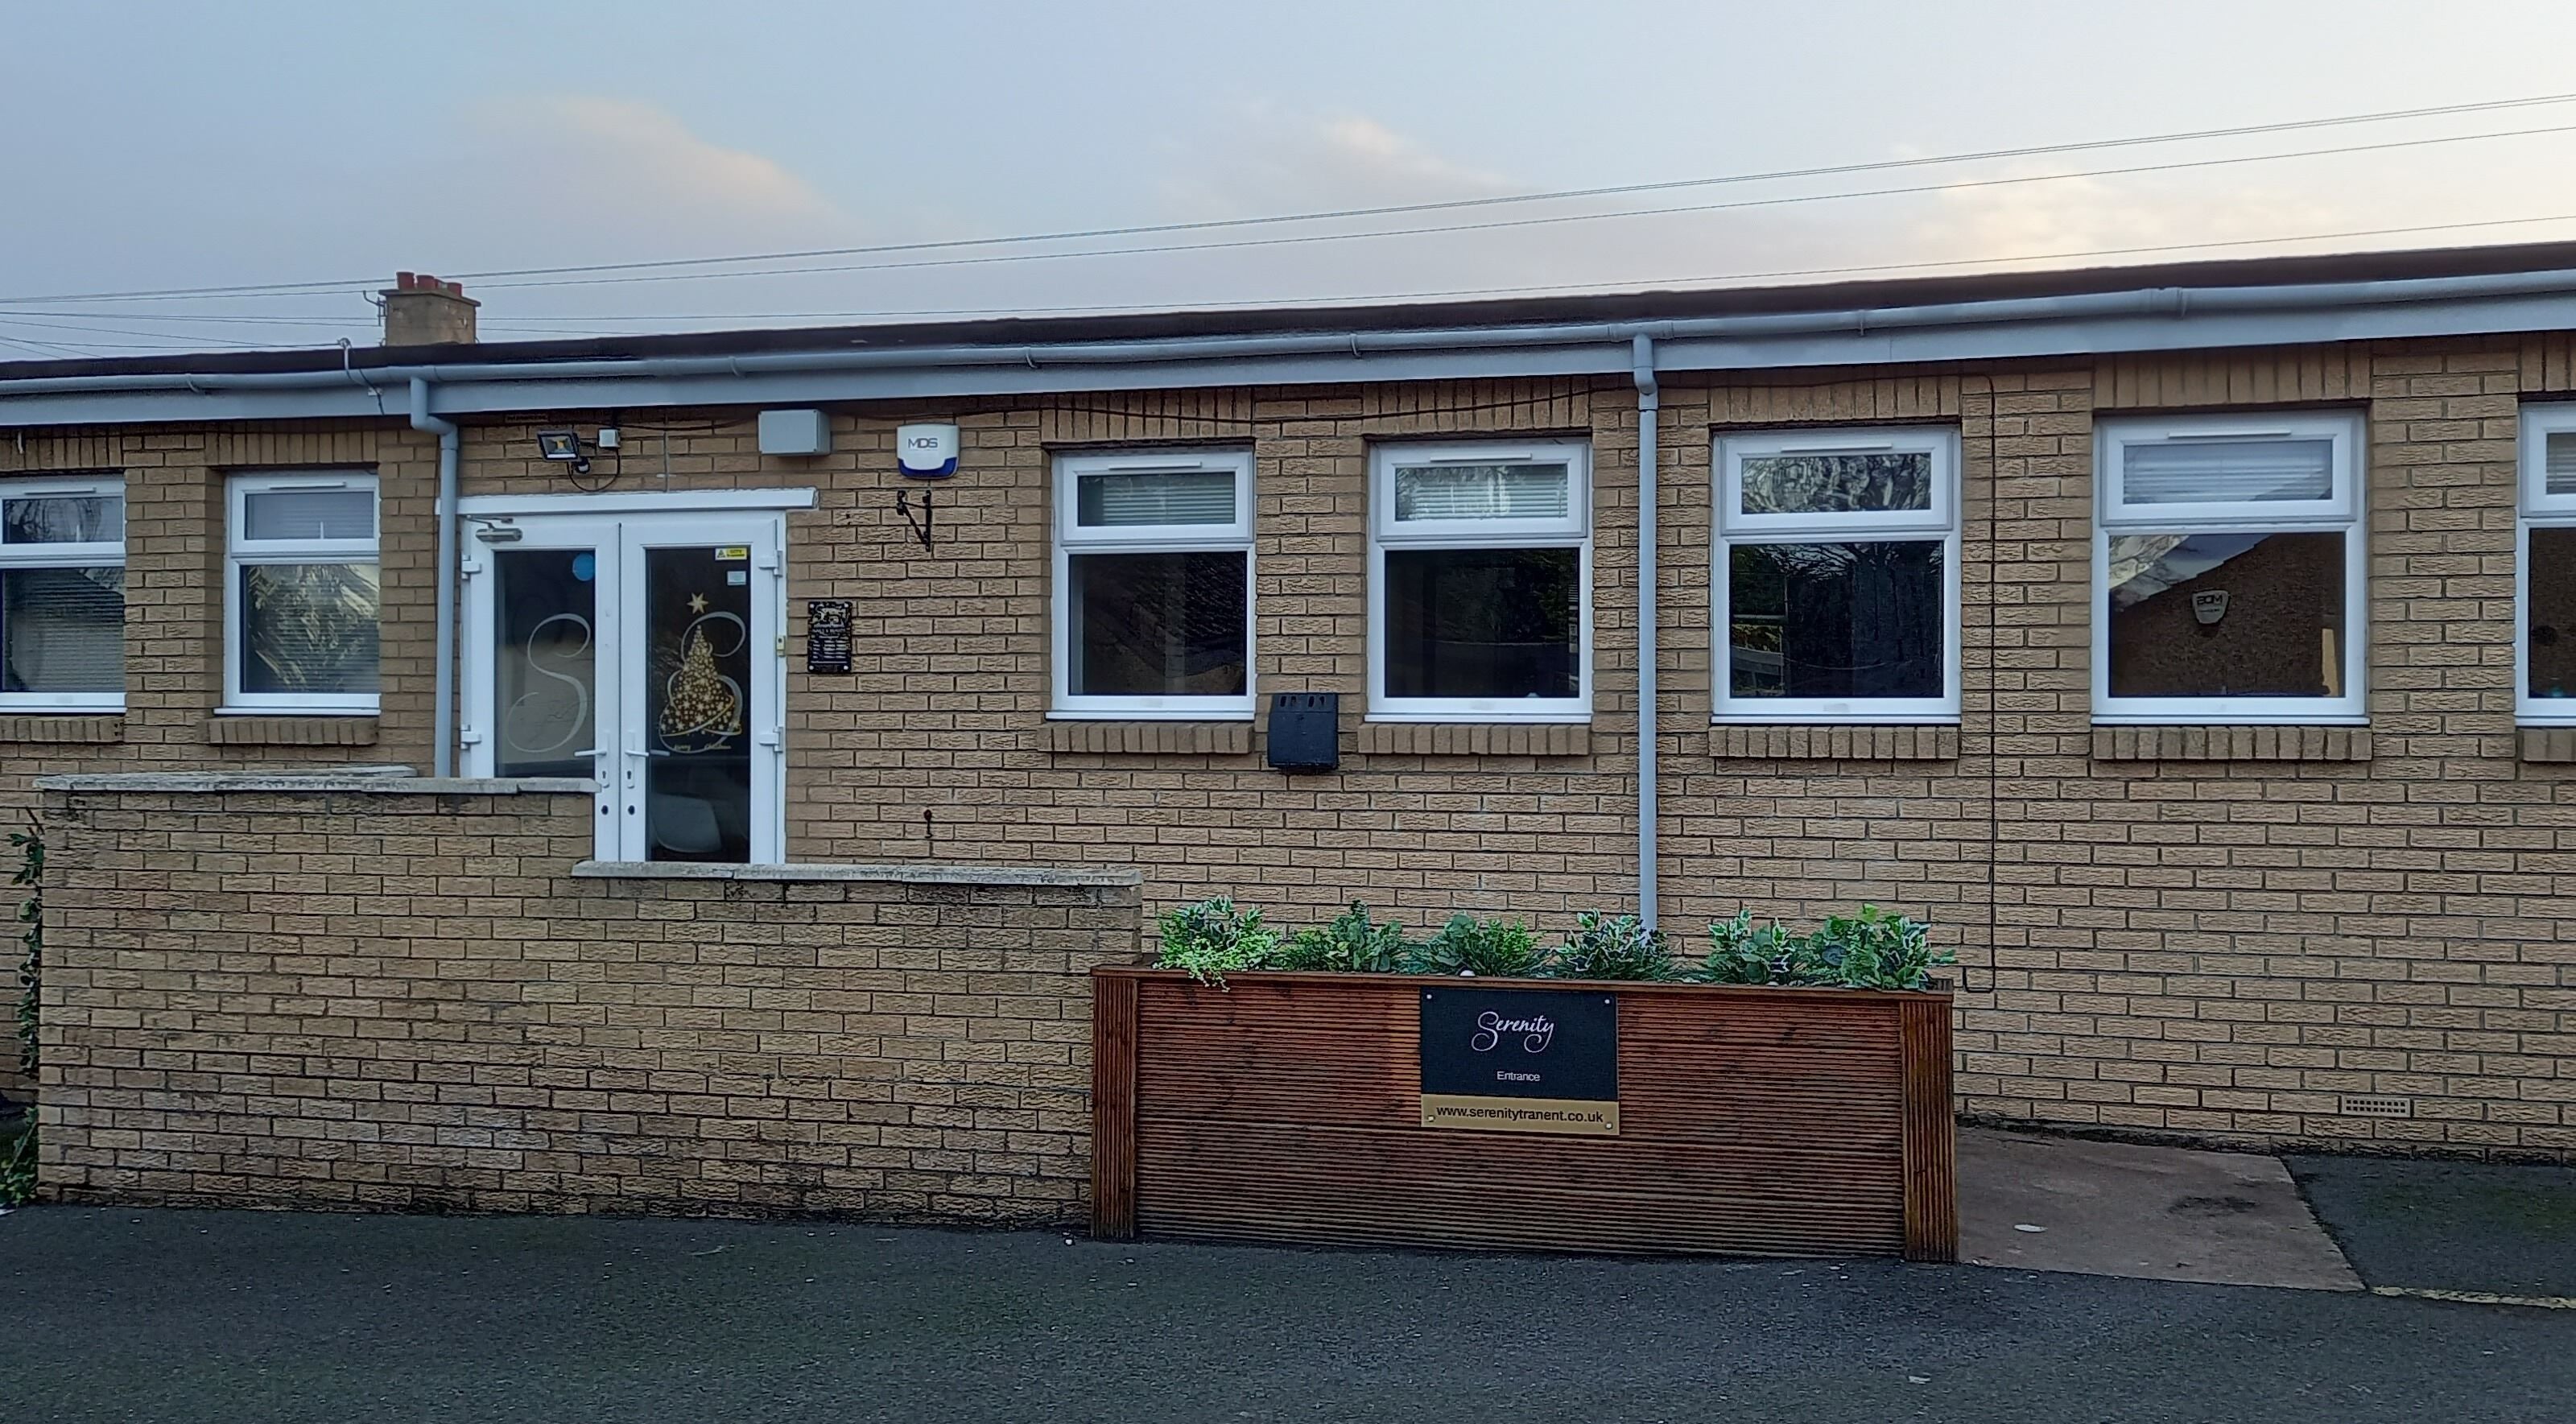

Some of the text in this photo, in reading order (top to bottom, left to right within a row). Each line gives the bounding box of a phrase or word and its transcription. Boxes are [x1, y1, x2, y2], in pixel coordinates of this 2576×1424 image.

[908, 437, 939, 448] MDS
[1471, 1011, 1554, 1053] Serenity
[1496, 1071, 1541, 1082] Entrance
[1436, 1105, 1604, 1123] www.serenitytranent.co.uk
